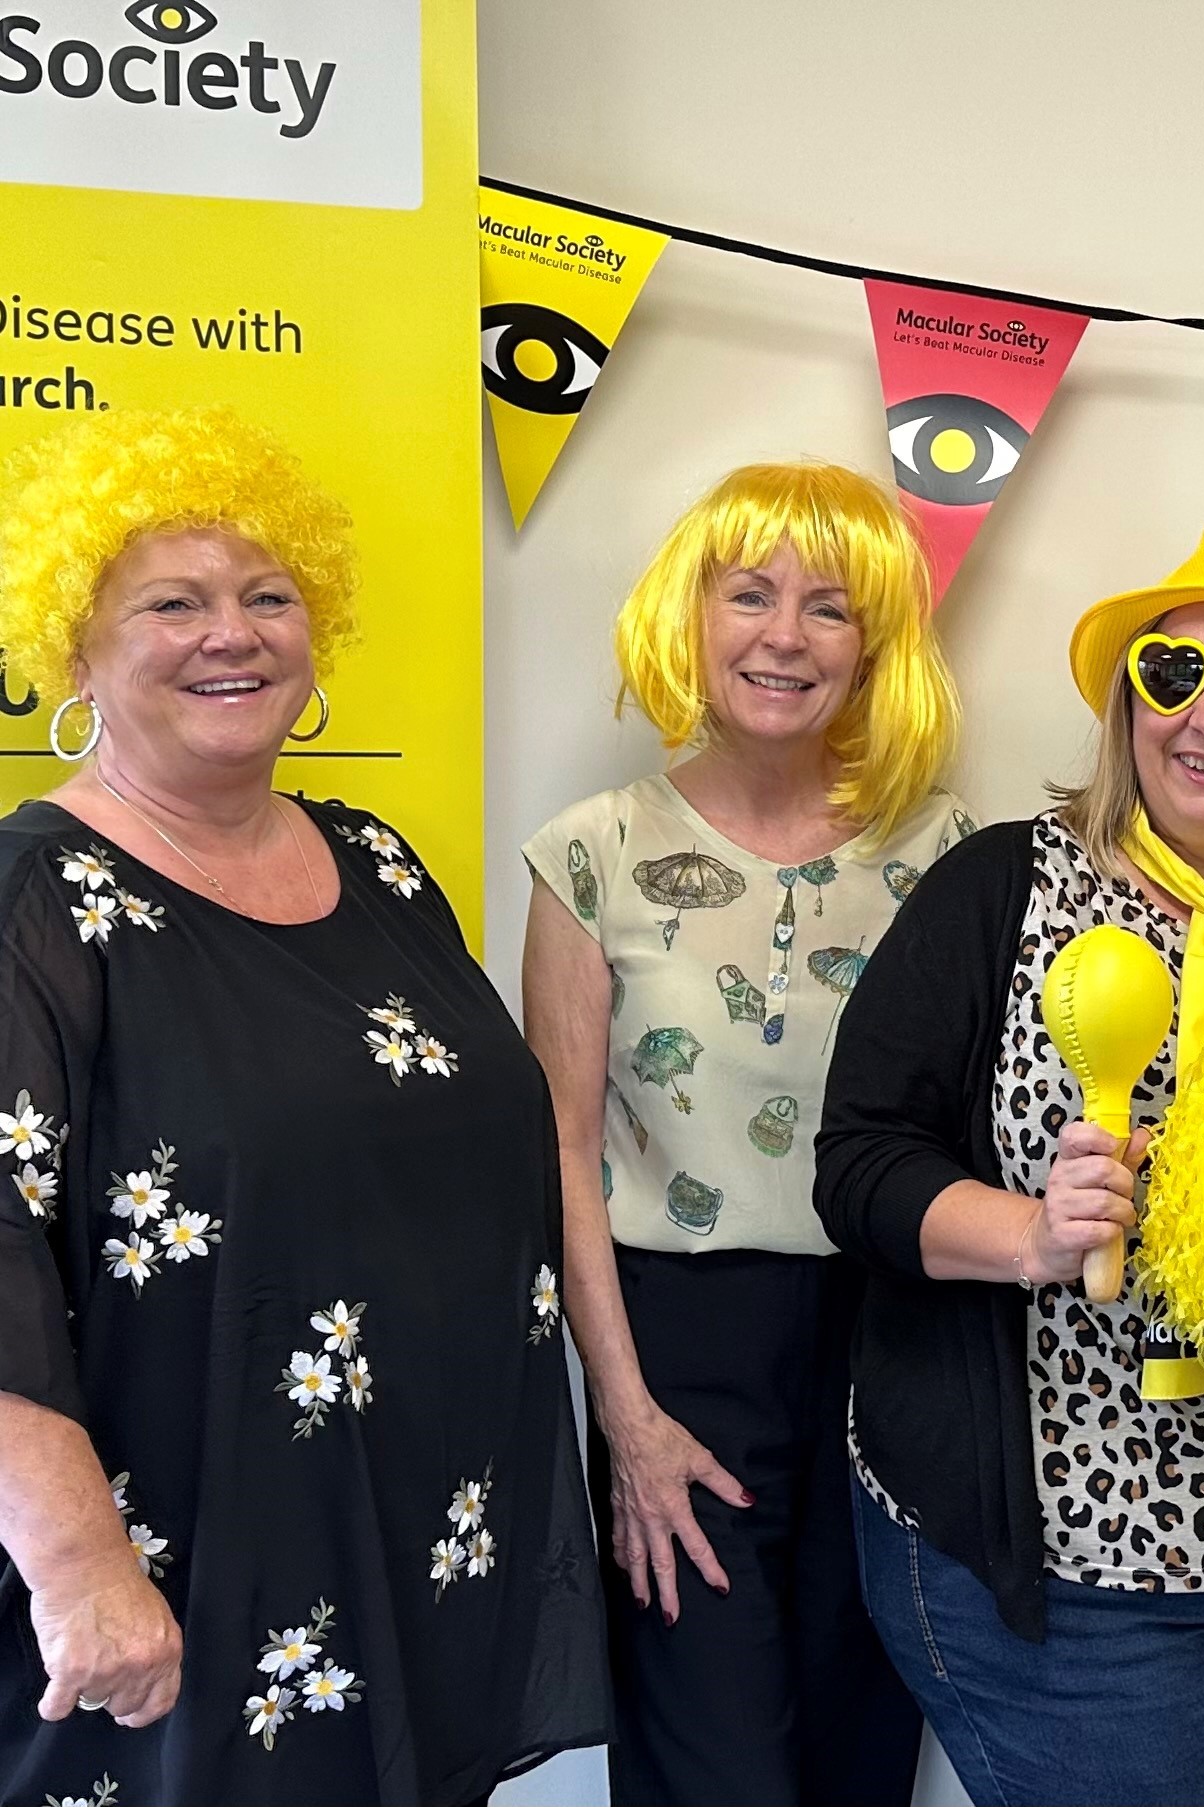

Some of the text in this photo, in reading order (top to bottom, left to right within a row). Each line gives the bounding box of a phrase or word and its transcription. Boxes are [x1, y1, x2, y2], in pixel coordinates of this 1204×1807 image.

[0, 15, 337, 139] Society
[500, 244, 526, 260] Beat
[529, 252, 575, 273] Macular
[578, 265, 622, 285] Disease
[555, 235, 628, 272] Society
[0, 294, 302, 354] isease with
[896, 308, 1050, 355] Macular Society
[893, 331, 1045, 367] Let's Beat Macular Disease
[0, 366, 109, 411] rch.
